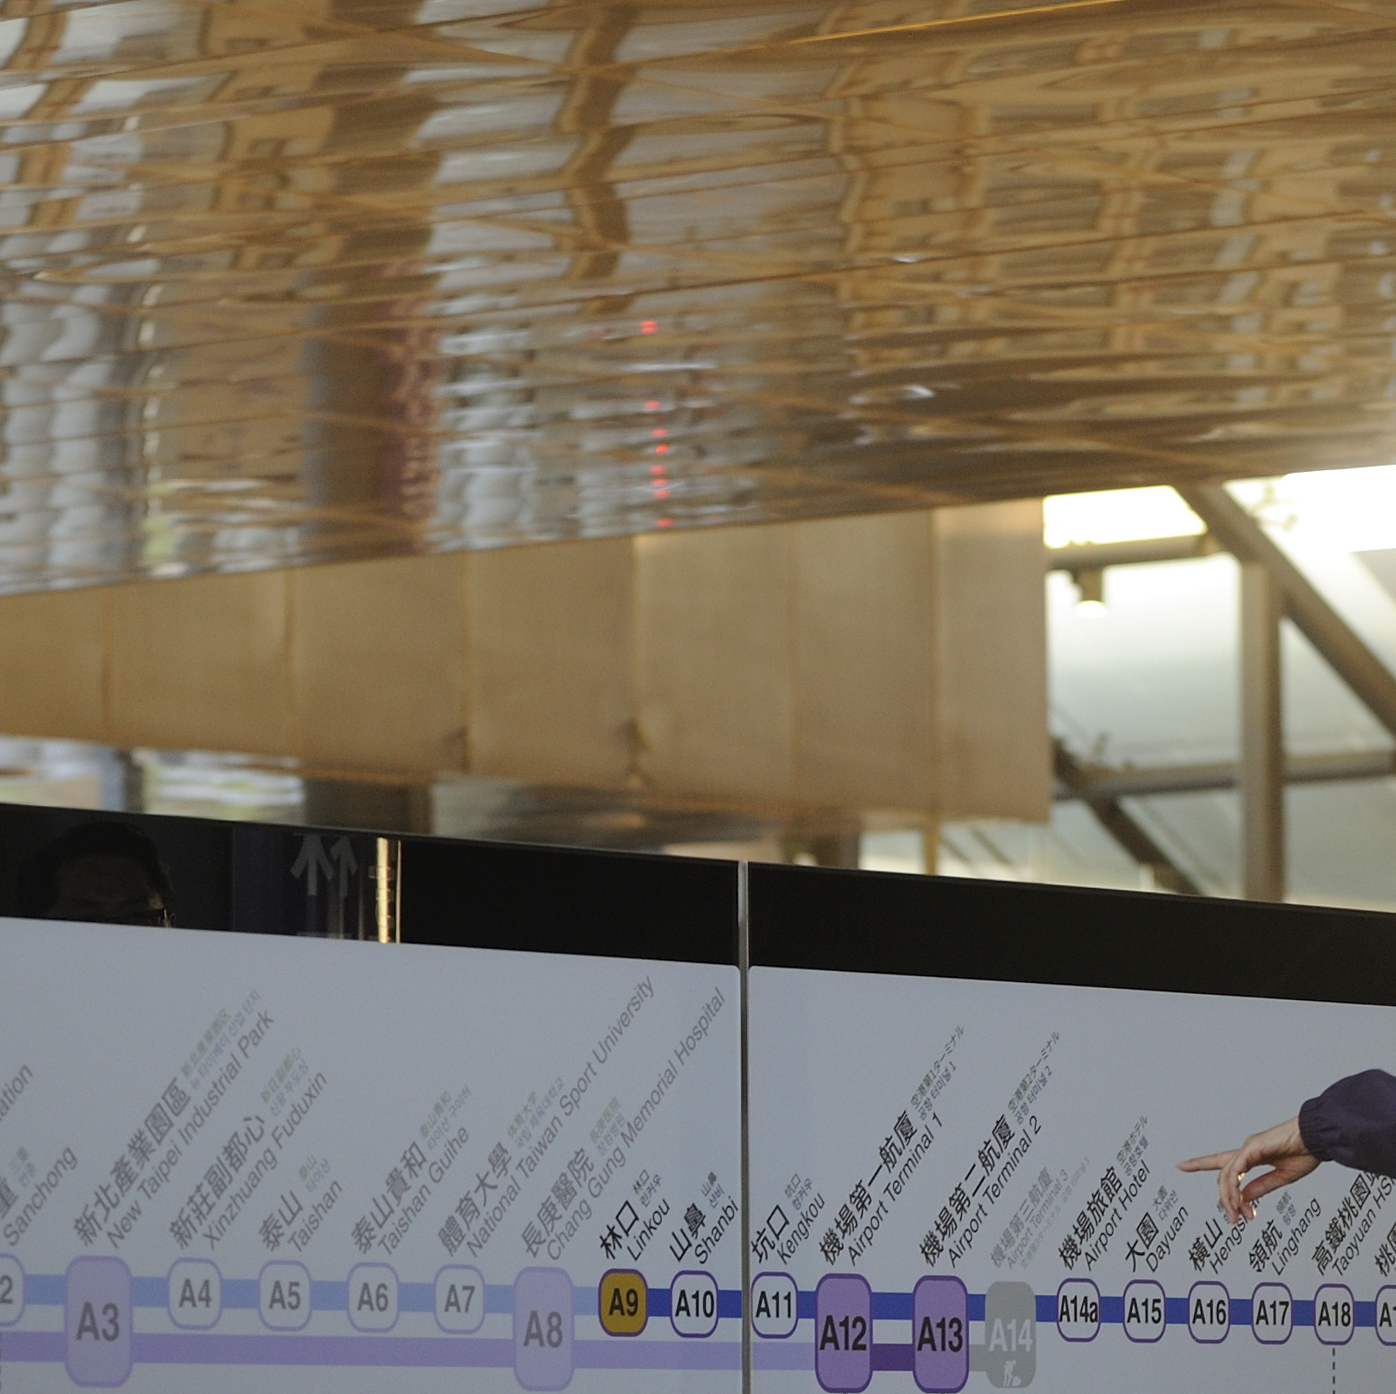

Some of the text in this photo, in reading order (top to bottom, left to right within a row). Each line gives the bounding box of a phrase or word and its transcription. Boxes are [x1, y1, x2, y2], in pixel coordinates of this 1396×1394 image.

[106, 1010, 274, 1249] New Taipei Industrial Park
[466, 975, 655, 1258] National Taiwan Sport University
[547, 987, 726, 1261] Chang Gung Memorial Hospital
[73, 1077, 192, 1247] 新北產業園區
[169, 1114, 265, 1250] 新莊副都心
[202, 1070, 328, 1251] Xinzhuang Fuduxin
[377, 1126, 470, 1256] Taishan Guihe
[819, 1109, 918, 1266] 機場第一航廈
[847, 1112, 944, 1267] Airport Terminal 1
[919, 1114, 1015, 1267] 機場第二航廈
[947, 1115, 1042, 1269] Airport Terminal 2
[3, 1147, 78, 1246] Sanchong
[259, 1190, 303, 1252] 泰山
[287, 1180, 343, 1253] Taishan
[352, 1141, 427, 1255] 泰山貴和
[438, 1141, 512, 1257] 體育大學
[522, 1147, 595, 1258] 長庚醫院
[599, 1199, 639, 1261] 林口
[626, 1198, 671, 1262] Linkou
[693, 1195, 739, 1265] Shanbi
[775, 1193, 826, 1265] Kengkou
[1007, 1230, 1034, 1270] Airport
[1030, 1181, 1064, 1230] Terminal
[1058, 1165, 1123, 1271] 機場旅館
[1083, 1159, 1151, 1272] Airport Hotel
[1331, 1177, 1395, 1278] Taoyuan HS
[669, 1202, 706, 1262] 山鼻
[750, 1204, 790, 1264] 坑口
[1125, 1212, 1159, 1272] 大園
[1145, 1206, 1189, 1273] Dayuan
[1209, 1199, 1260, 1275] Hengsn
[1248, 1219, 1283, 1273] 領航
[1271, 1198, 1322, 1277] Linghang
[76, 1302, 119, 1341] A3
[179, 1278, 212, 1308] A4
[269, 1280, 301, 1310] A5
[357, 1282, 389, 1312] A6
[444, 1284, 476, 1313] A7
[608, 1287, 639, 1317] A9
[675, 1289, 715, 1318] A10
[755, 1290, 792, 1318] A11
[1059, 1295, 1099, 1324] A14a
[1127, 1297, 1162, 1324] A15
[1192, 1298, 1227, 1326] A16
[1256, 1300, 1290, 1326] A17
[1318, 1301, 1352, 1327] A18
[523, 1310, 563, 1348] A8
[820, 1315, 867, 1351] A12
[917, 1316, 963, 1352] A13
[989, 1318, 1033, 1352] A14
